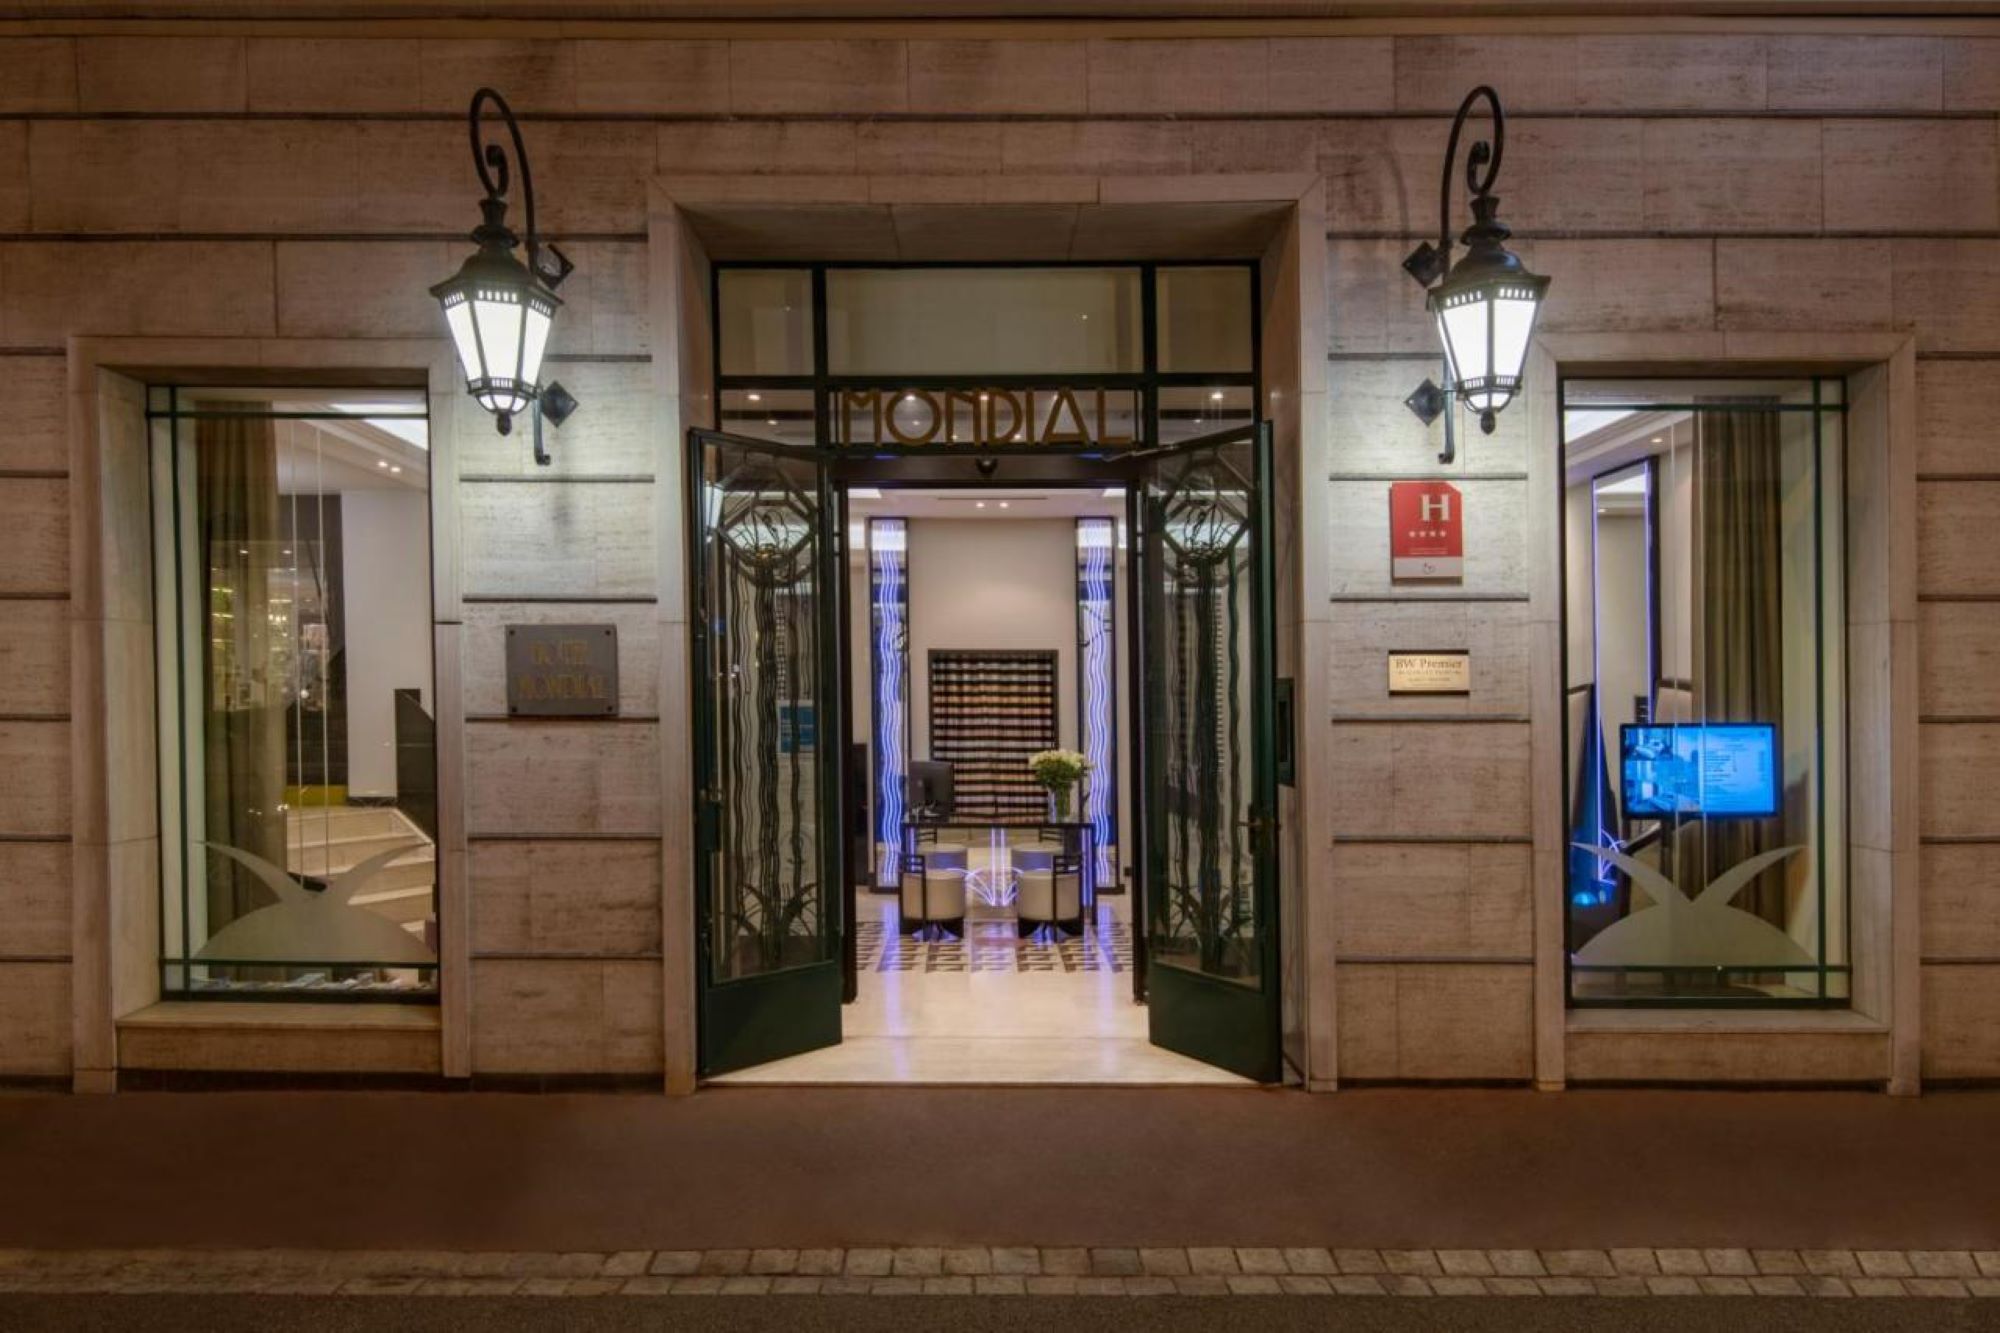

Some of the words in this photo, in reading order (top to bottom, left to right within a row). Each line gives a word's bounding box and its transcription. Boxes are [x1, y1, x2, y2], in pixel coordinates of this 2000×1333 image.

[842, 387, 1132, 447] MONDIAL
[1421, 493, 1450, 522] H
[1395, 658, 1415, 669] BW
[1419, 658, 1462, 669] Premier
